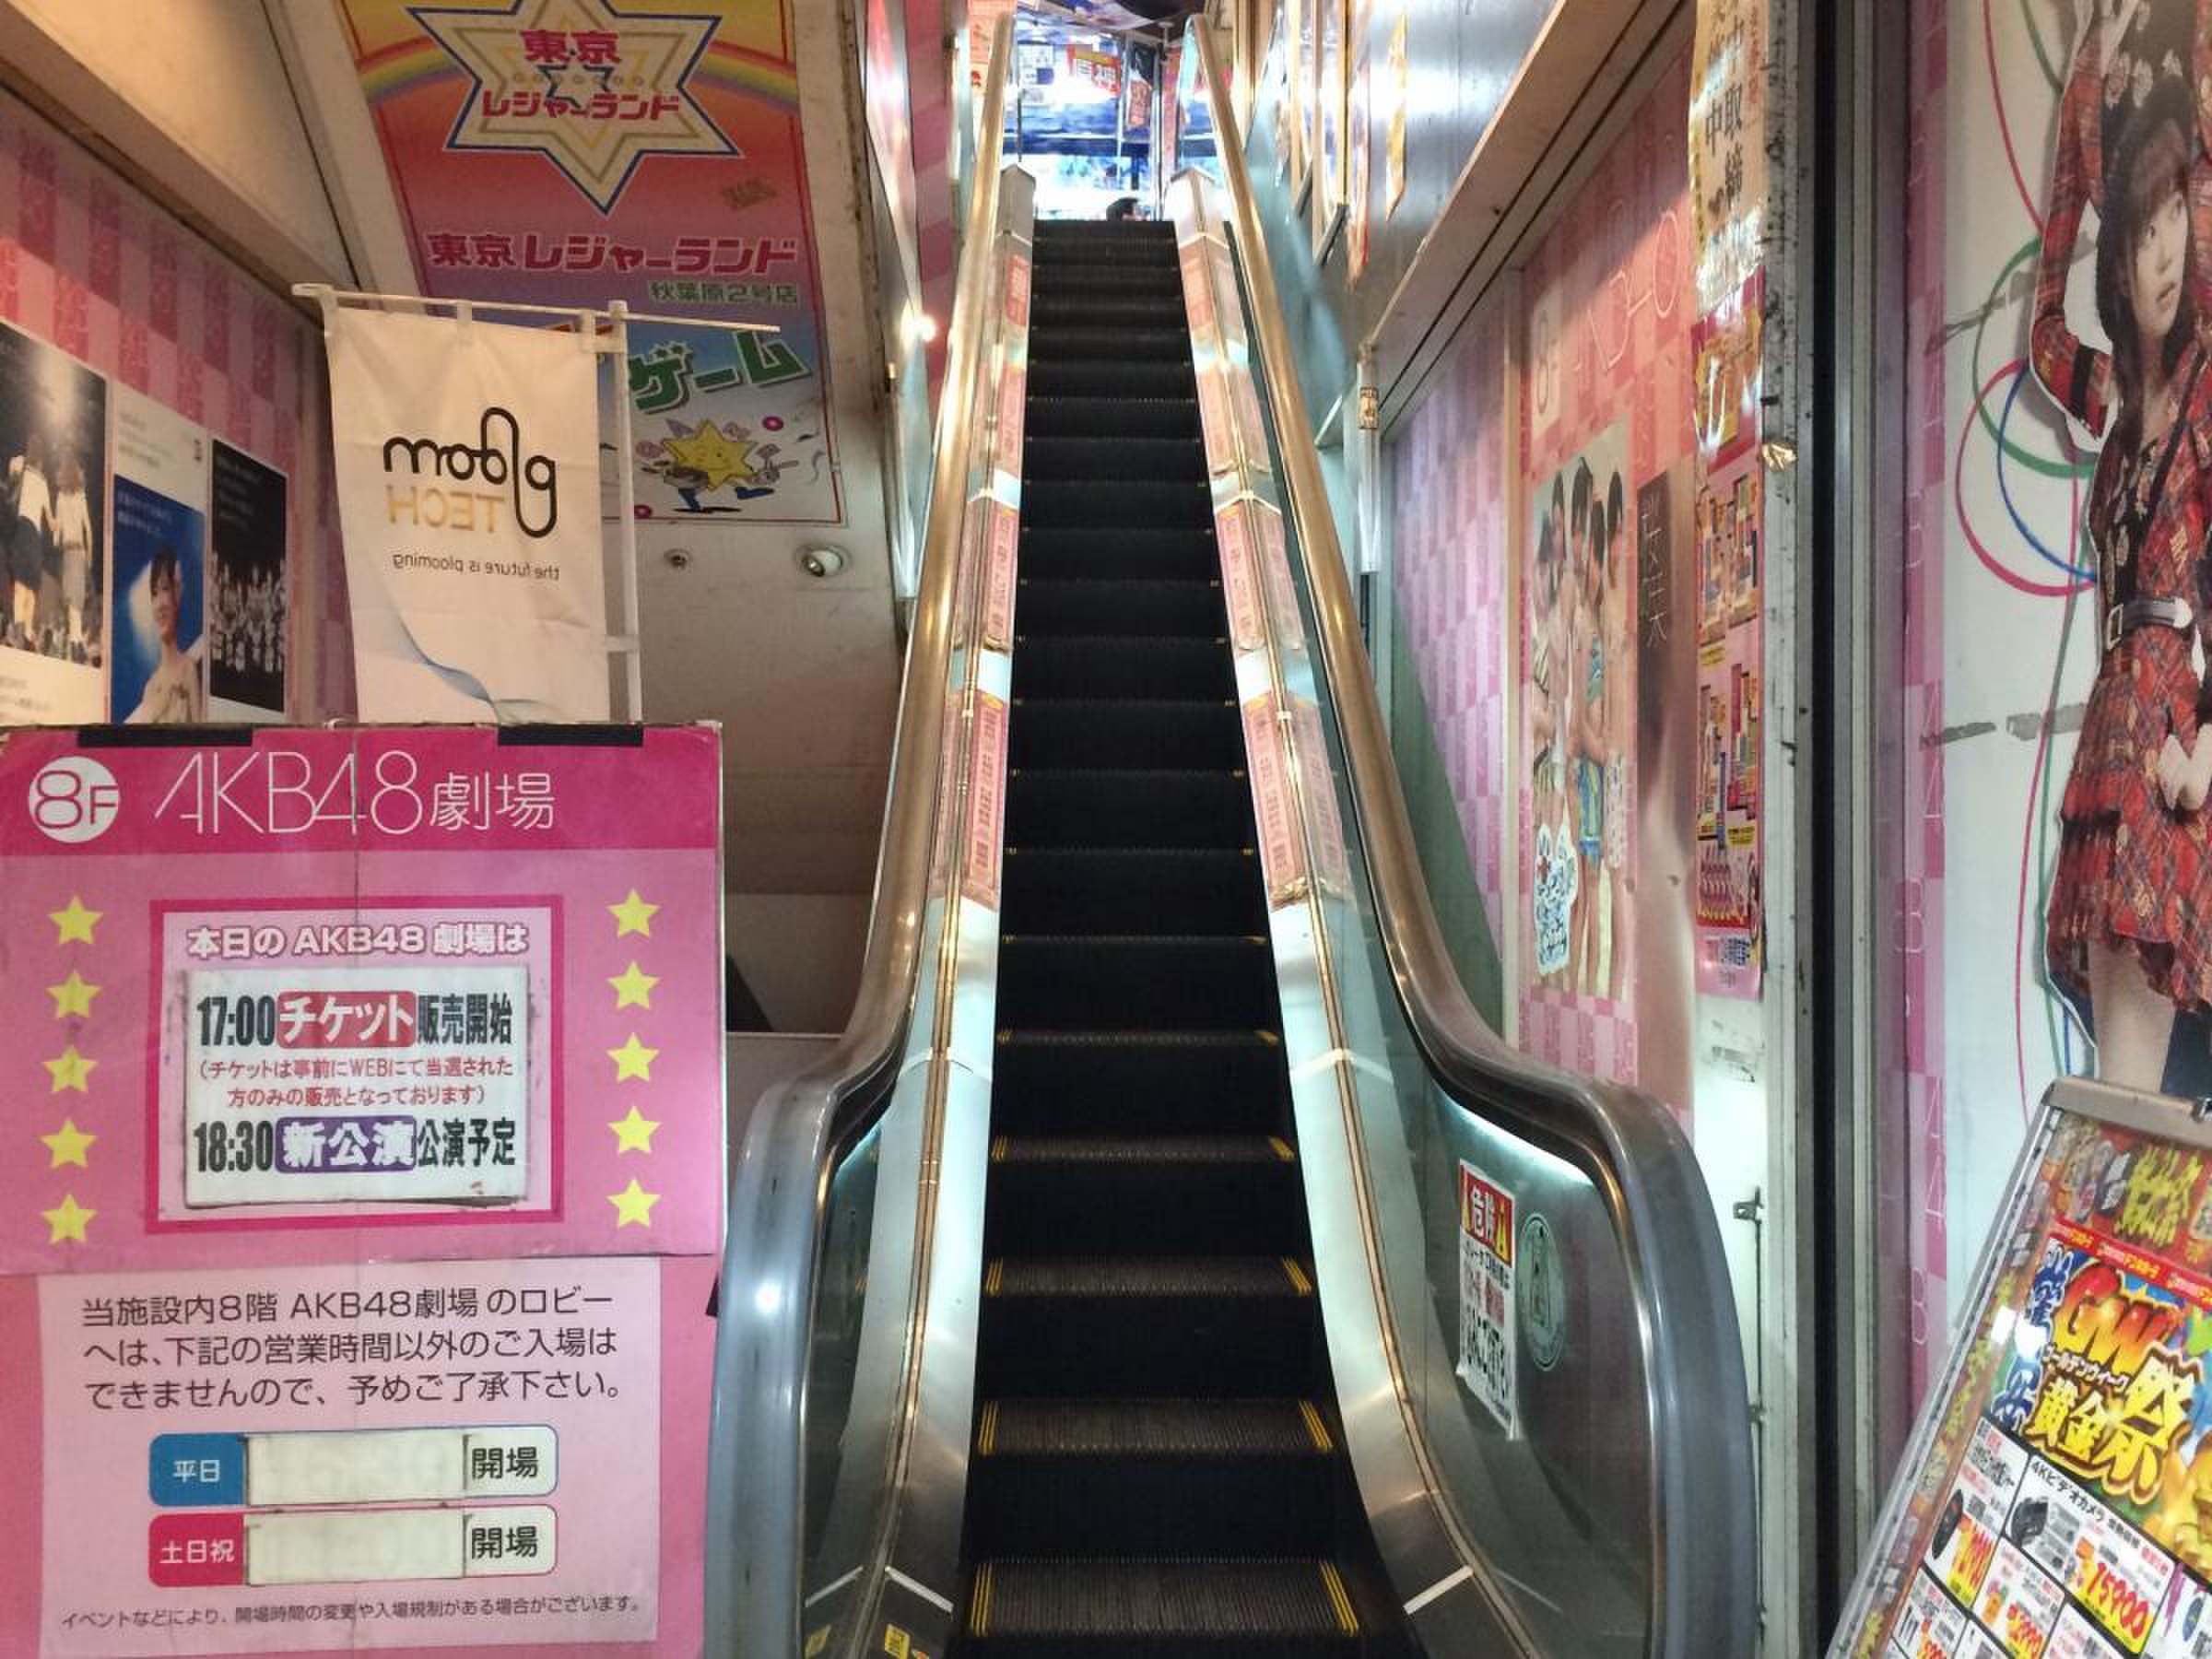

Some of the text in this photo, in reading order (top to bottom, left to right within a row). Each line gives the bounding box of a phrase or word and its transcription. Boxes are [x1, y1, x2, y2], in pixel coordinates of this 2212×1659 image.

[520, 29, 621, 64] 東京
[482, 89, 679, 120] レジャーランド
[427, 232, 797, 275] 東京レジャーランド
[650, 280, 799, 305] 秋葉原2号店
[34, 769, 119, 830] 8F
[187, 923, 529, 959] 本日の AKB48 劇場は
[81, 1285, 613, 1327] 当施設内8階 AKB48劇場 のロビー
[2051, 1263, 2183, 1380] GW
[83, 1327, 618, 1368] へは、下記の営業時間以外のご入場は
[172, 1446, 538, 1484] 平日 開場
[159, 1525, 538, 1565] 土日祝 開場
